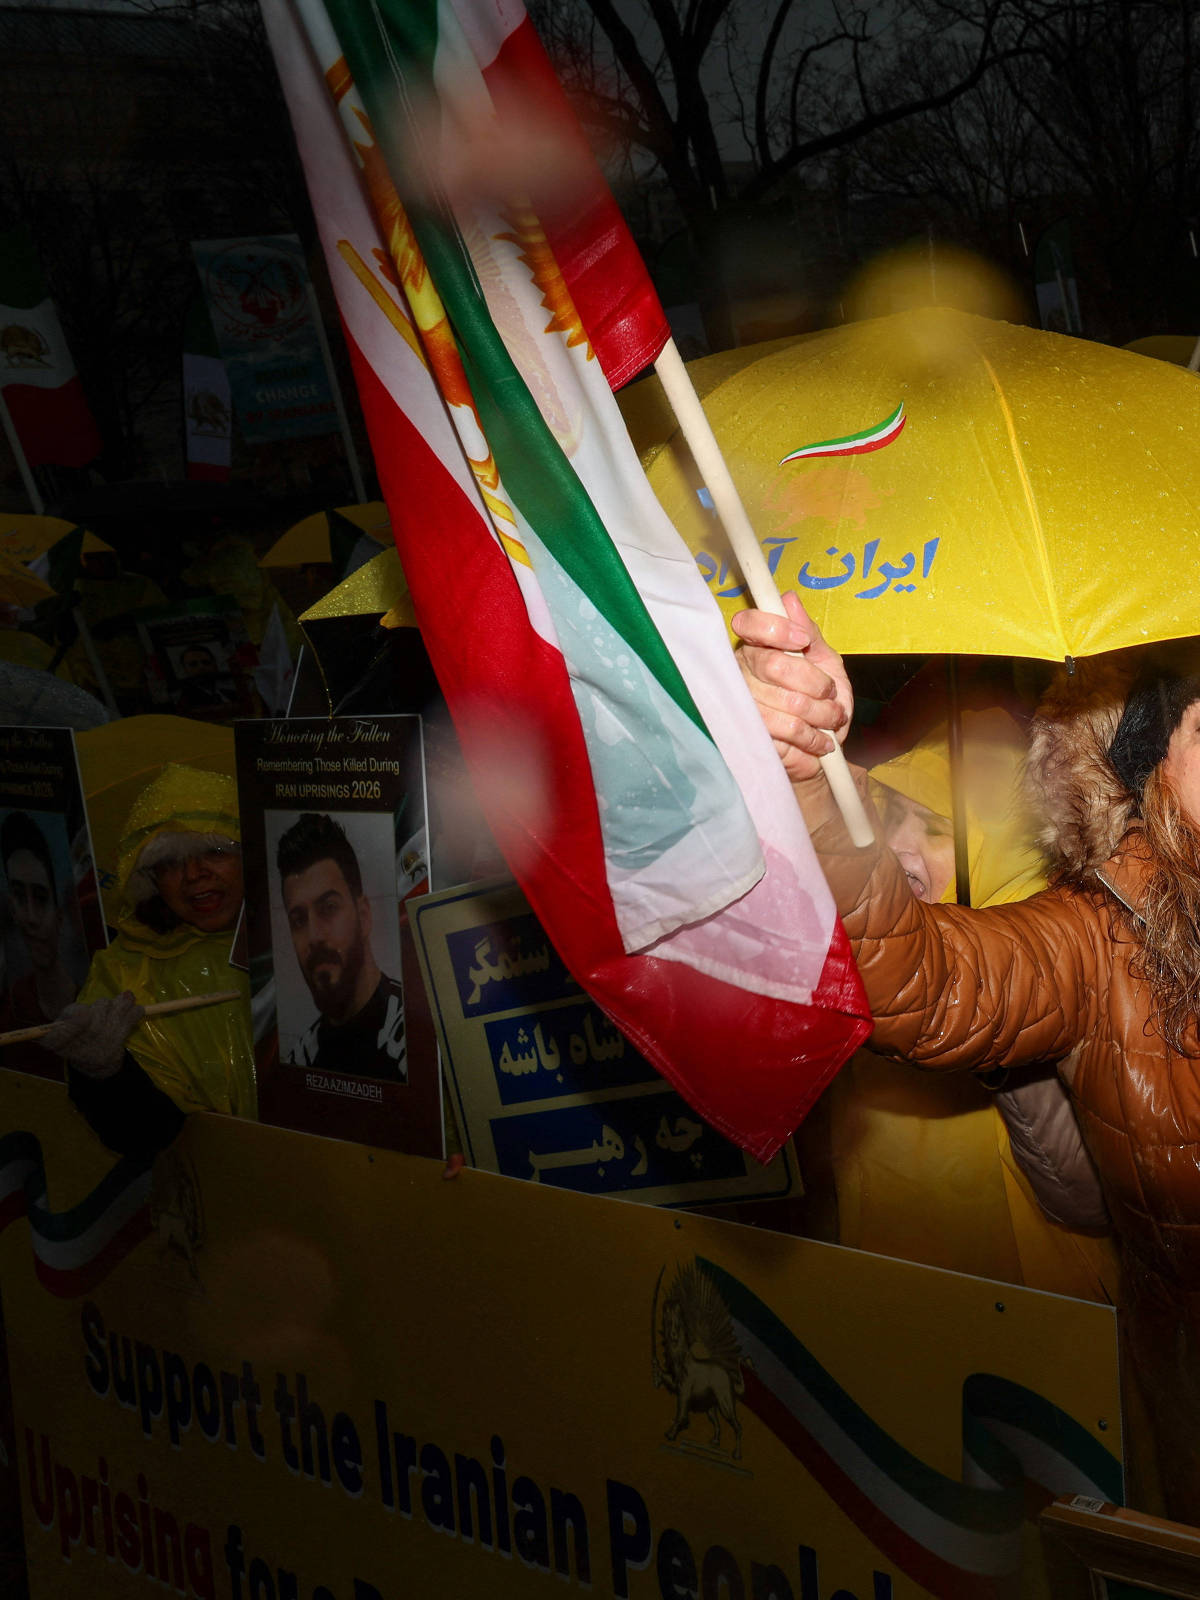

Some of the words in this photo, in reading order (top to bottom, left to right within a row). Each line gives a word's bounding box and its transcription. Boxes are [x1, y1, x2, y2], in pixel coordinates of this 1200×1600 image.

[255, 383, 319, 404] CHANGE
[798, 537, 940, 599] ایران
[264, 721, 325, 752] Honoring
[327, 724, 345, 744] the
[346, 720, 391, 744] Fallen
[256, 757, 314, 775] Remembering
[314, 757, 341, 772] Those
[343, 757, 367, 773] Killed
[369, 757, 400, 775] During
[275, 783, 297, 799] IRAN
[298, 783, 350, 799] UPRISINGS
[352, 780, 382, 799] 2026
[499, 1020, 564, 1085] باشه
[655, 1112, 704, 1170] چه
[81, 1301, 267, 1463] Support
[274, 1371, 365, 1500] the
[374, 1400, 593, 1589] Iranian
[24, 1427, 217, 1600] Uprising
